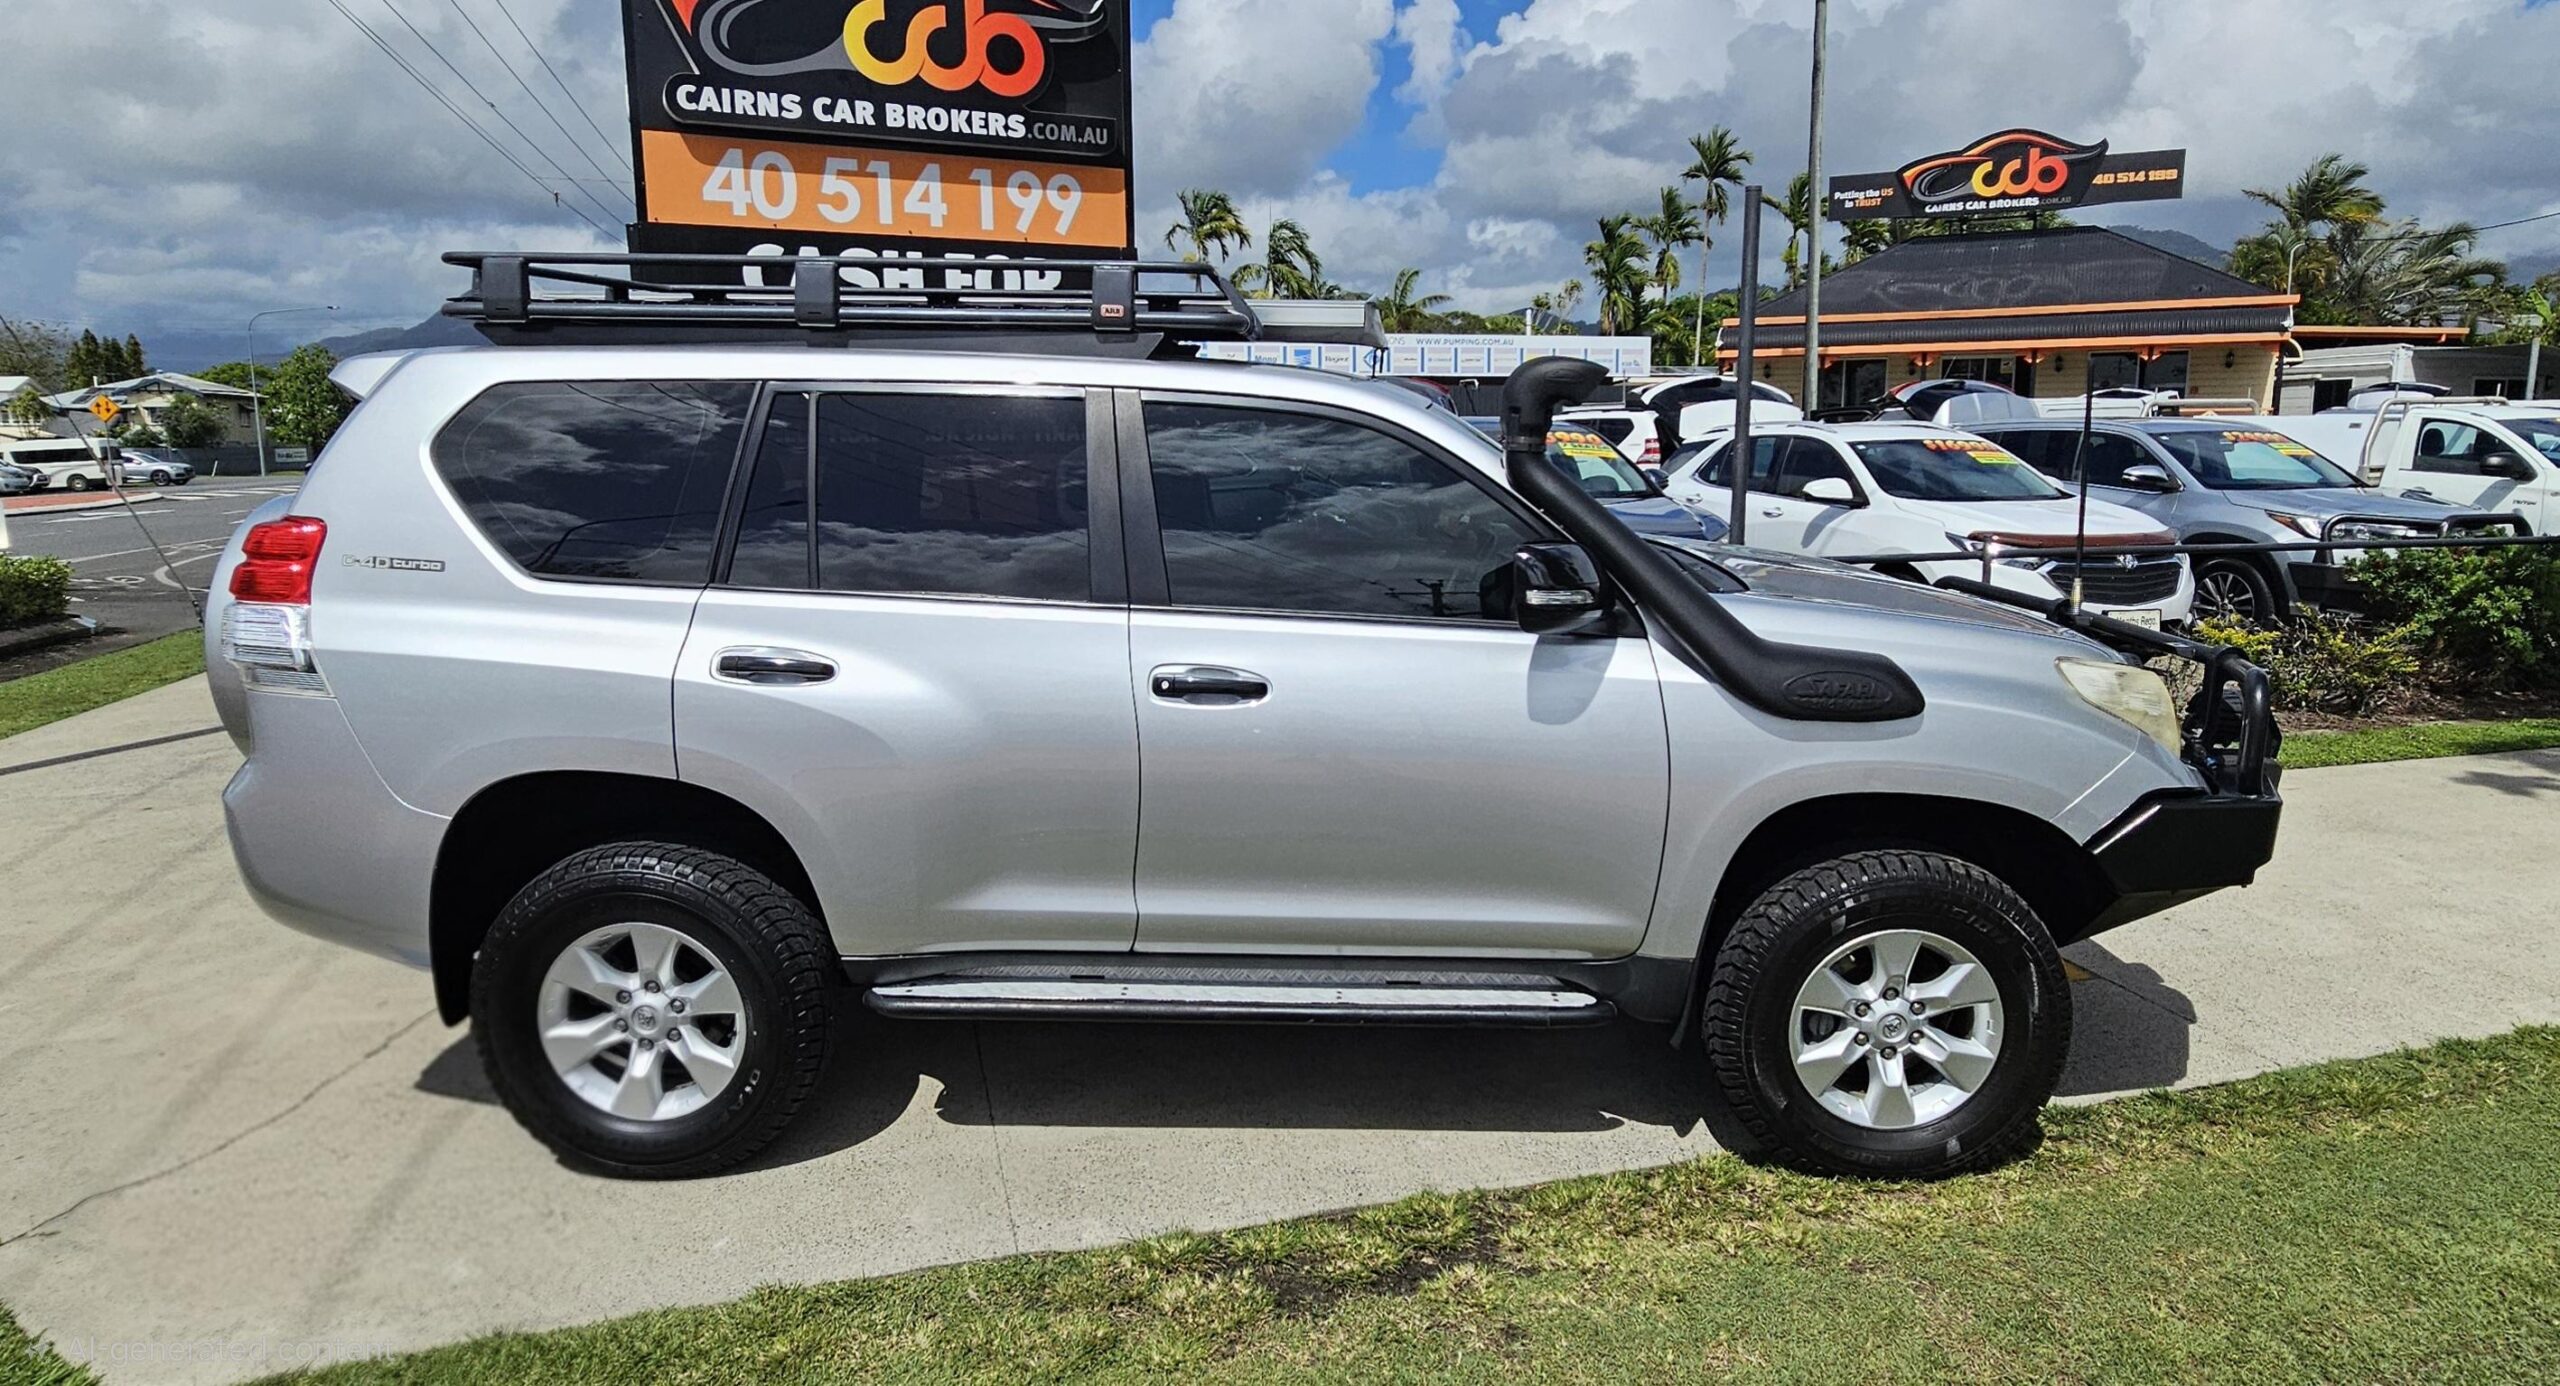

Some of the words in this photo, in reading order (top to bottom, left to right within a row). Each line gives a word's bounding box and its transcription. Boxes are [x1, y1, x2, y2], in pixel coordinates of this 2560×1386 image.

[676, 84, 803, 119] CAIRNS
[813, 97, 876, 126] CAR
[2092, 173, 2115, 184] 40
[2117, 171, 2146, 183] 514
[2148, 168, 2178, 181] 199
[702, 148, 797, 220] 40
[816, 156, 948, 228] 514
[969, 167, 1082, 236] 199
[1834, 190, 1865, 200] Putting
[1866, 189, 1880, 198] the
[1881, 187, 1894, 197] US
[1855, 198, 1881, 208] TRUST
[1925, 201, 1964, 213] CAIRNS
[1965, 200, 1987, 210] CAR
[1416, 338, 1514, 346] WWW.PUMPING.COM.AU
[392, 559, 441, 571] turbo
